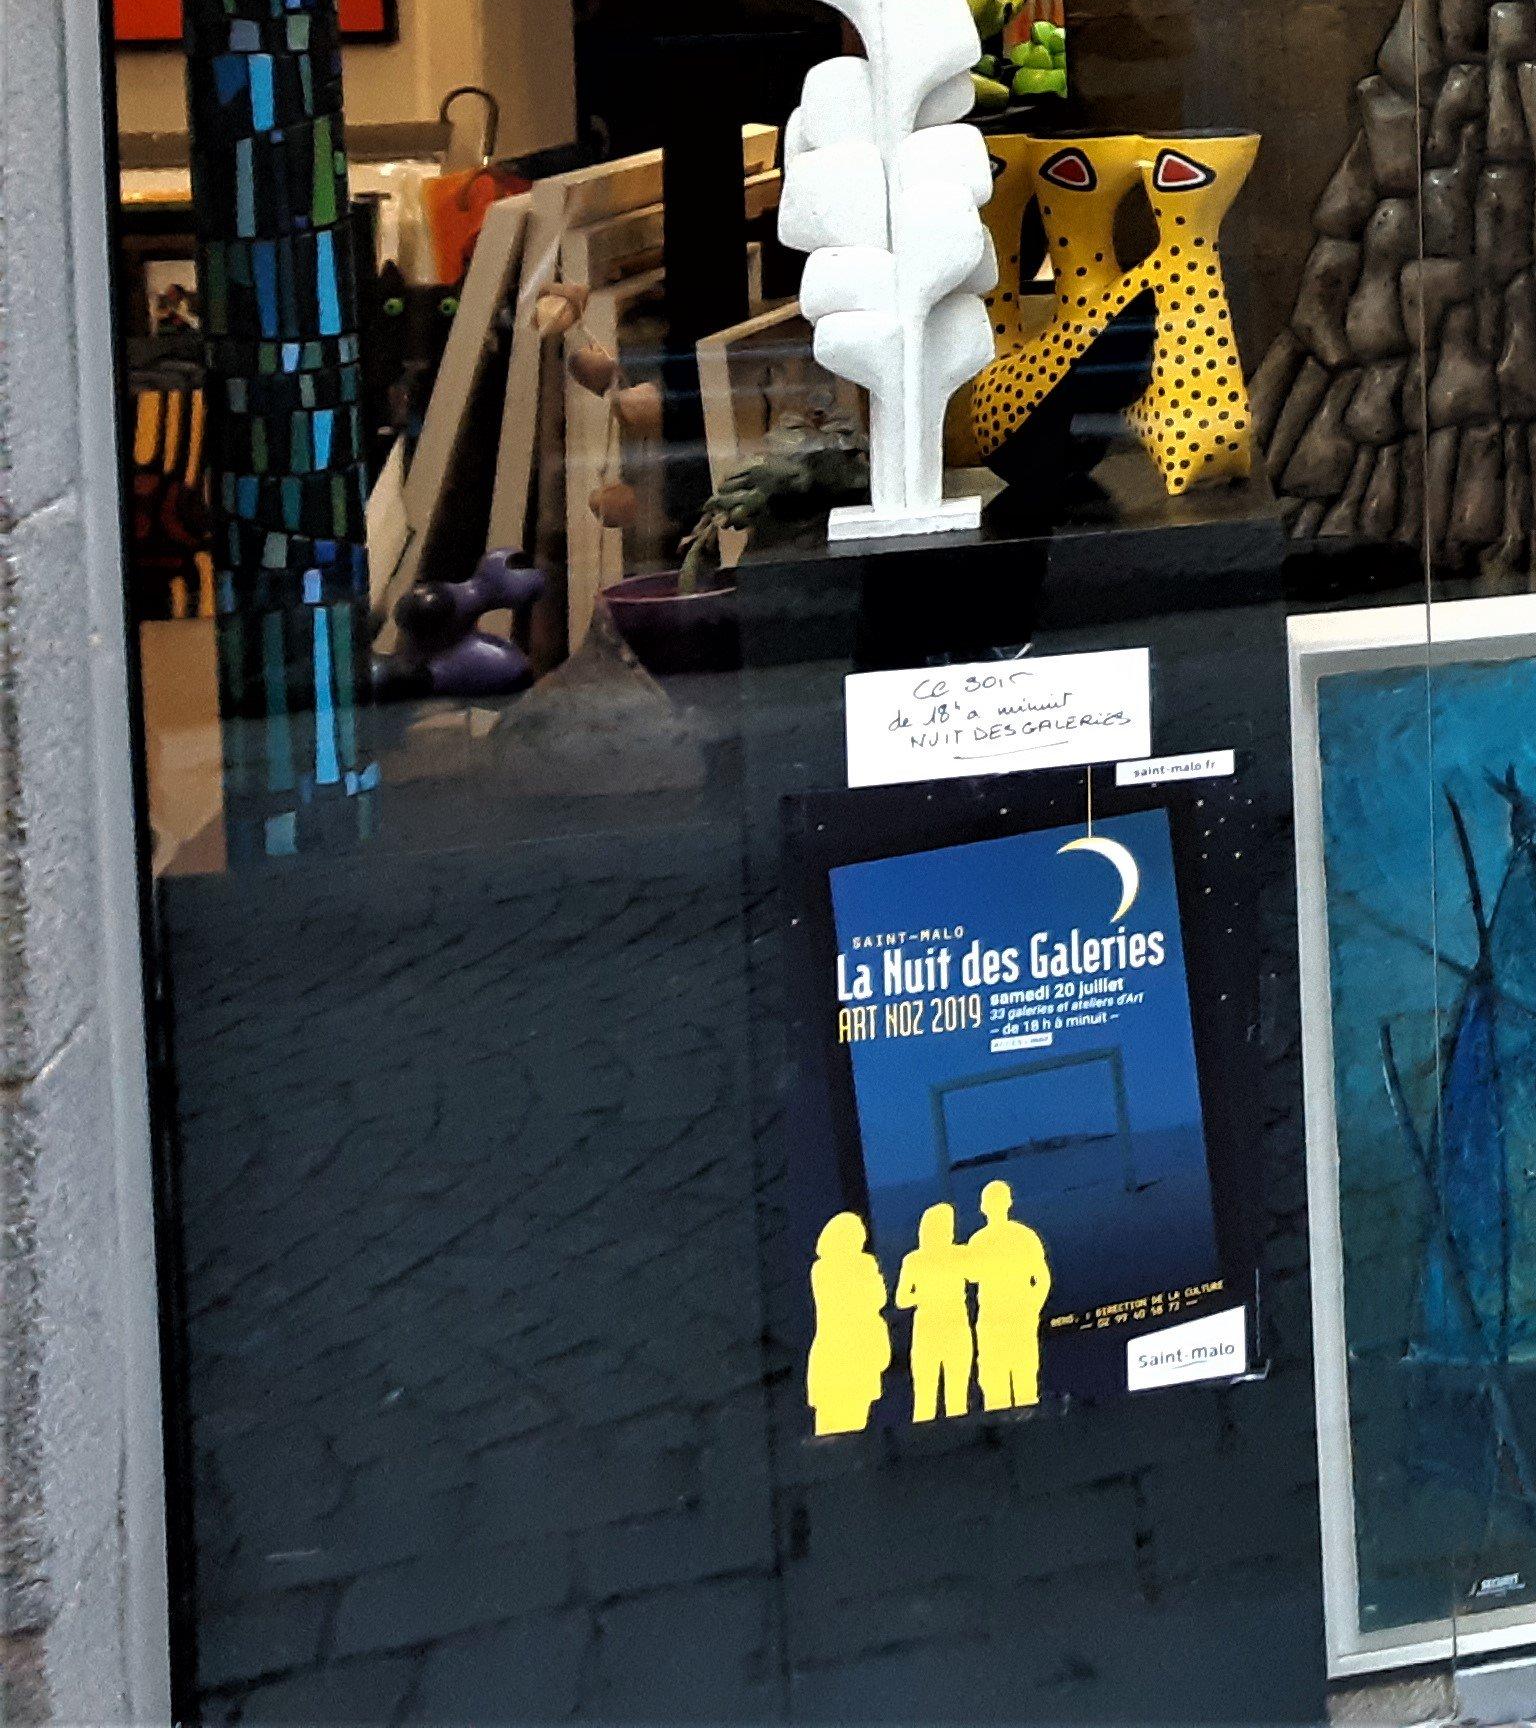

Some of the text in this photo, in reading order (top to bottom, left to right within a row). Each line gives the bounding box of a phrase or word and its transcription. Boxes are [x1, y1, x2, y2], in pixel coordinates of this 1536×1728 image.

[888, 709, 913, 732] de
[998, 692, 1073, 716] minuit
[911, 729, 964, 748] NUIT
[974, 723, 1016, 741] DES
[852, 925, 964, 949] SAINT-MALO
[837, 925, 1165, 1001] La Nuit des Galeries
[989, 976, 1125, 1007] samedi 20 juillet
[838, 992, 982, 1044] ART NOZ 2019
[1008, 1003, 1055, 1021] galeries
[1056, 1001, 1069, 1013] et
[1070, 994, 1115, 1012] ateliers
[1002, 1022, 1020, 1035] de
[1042, 1017, 1052, 1030] h
[1065, 1011, 1108, 1028] minuit
